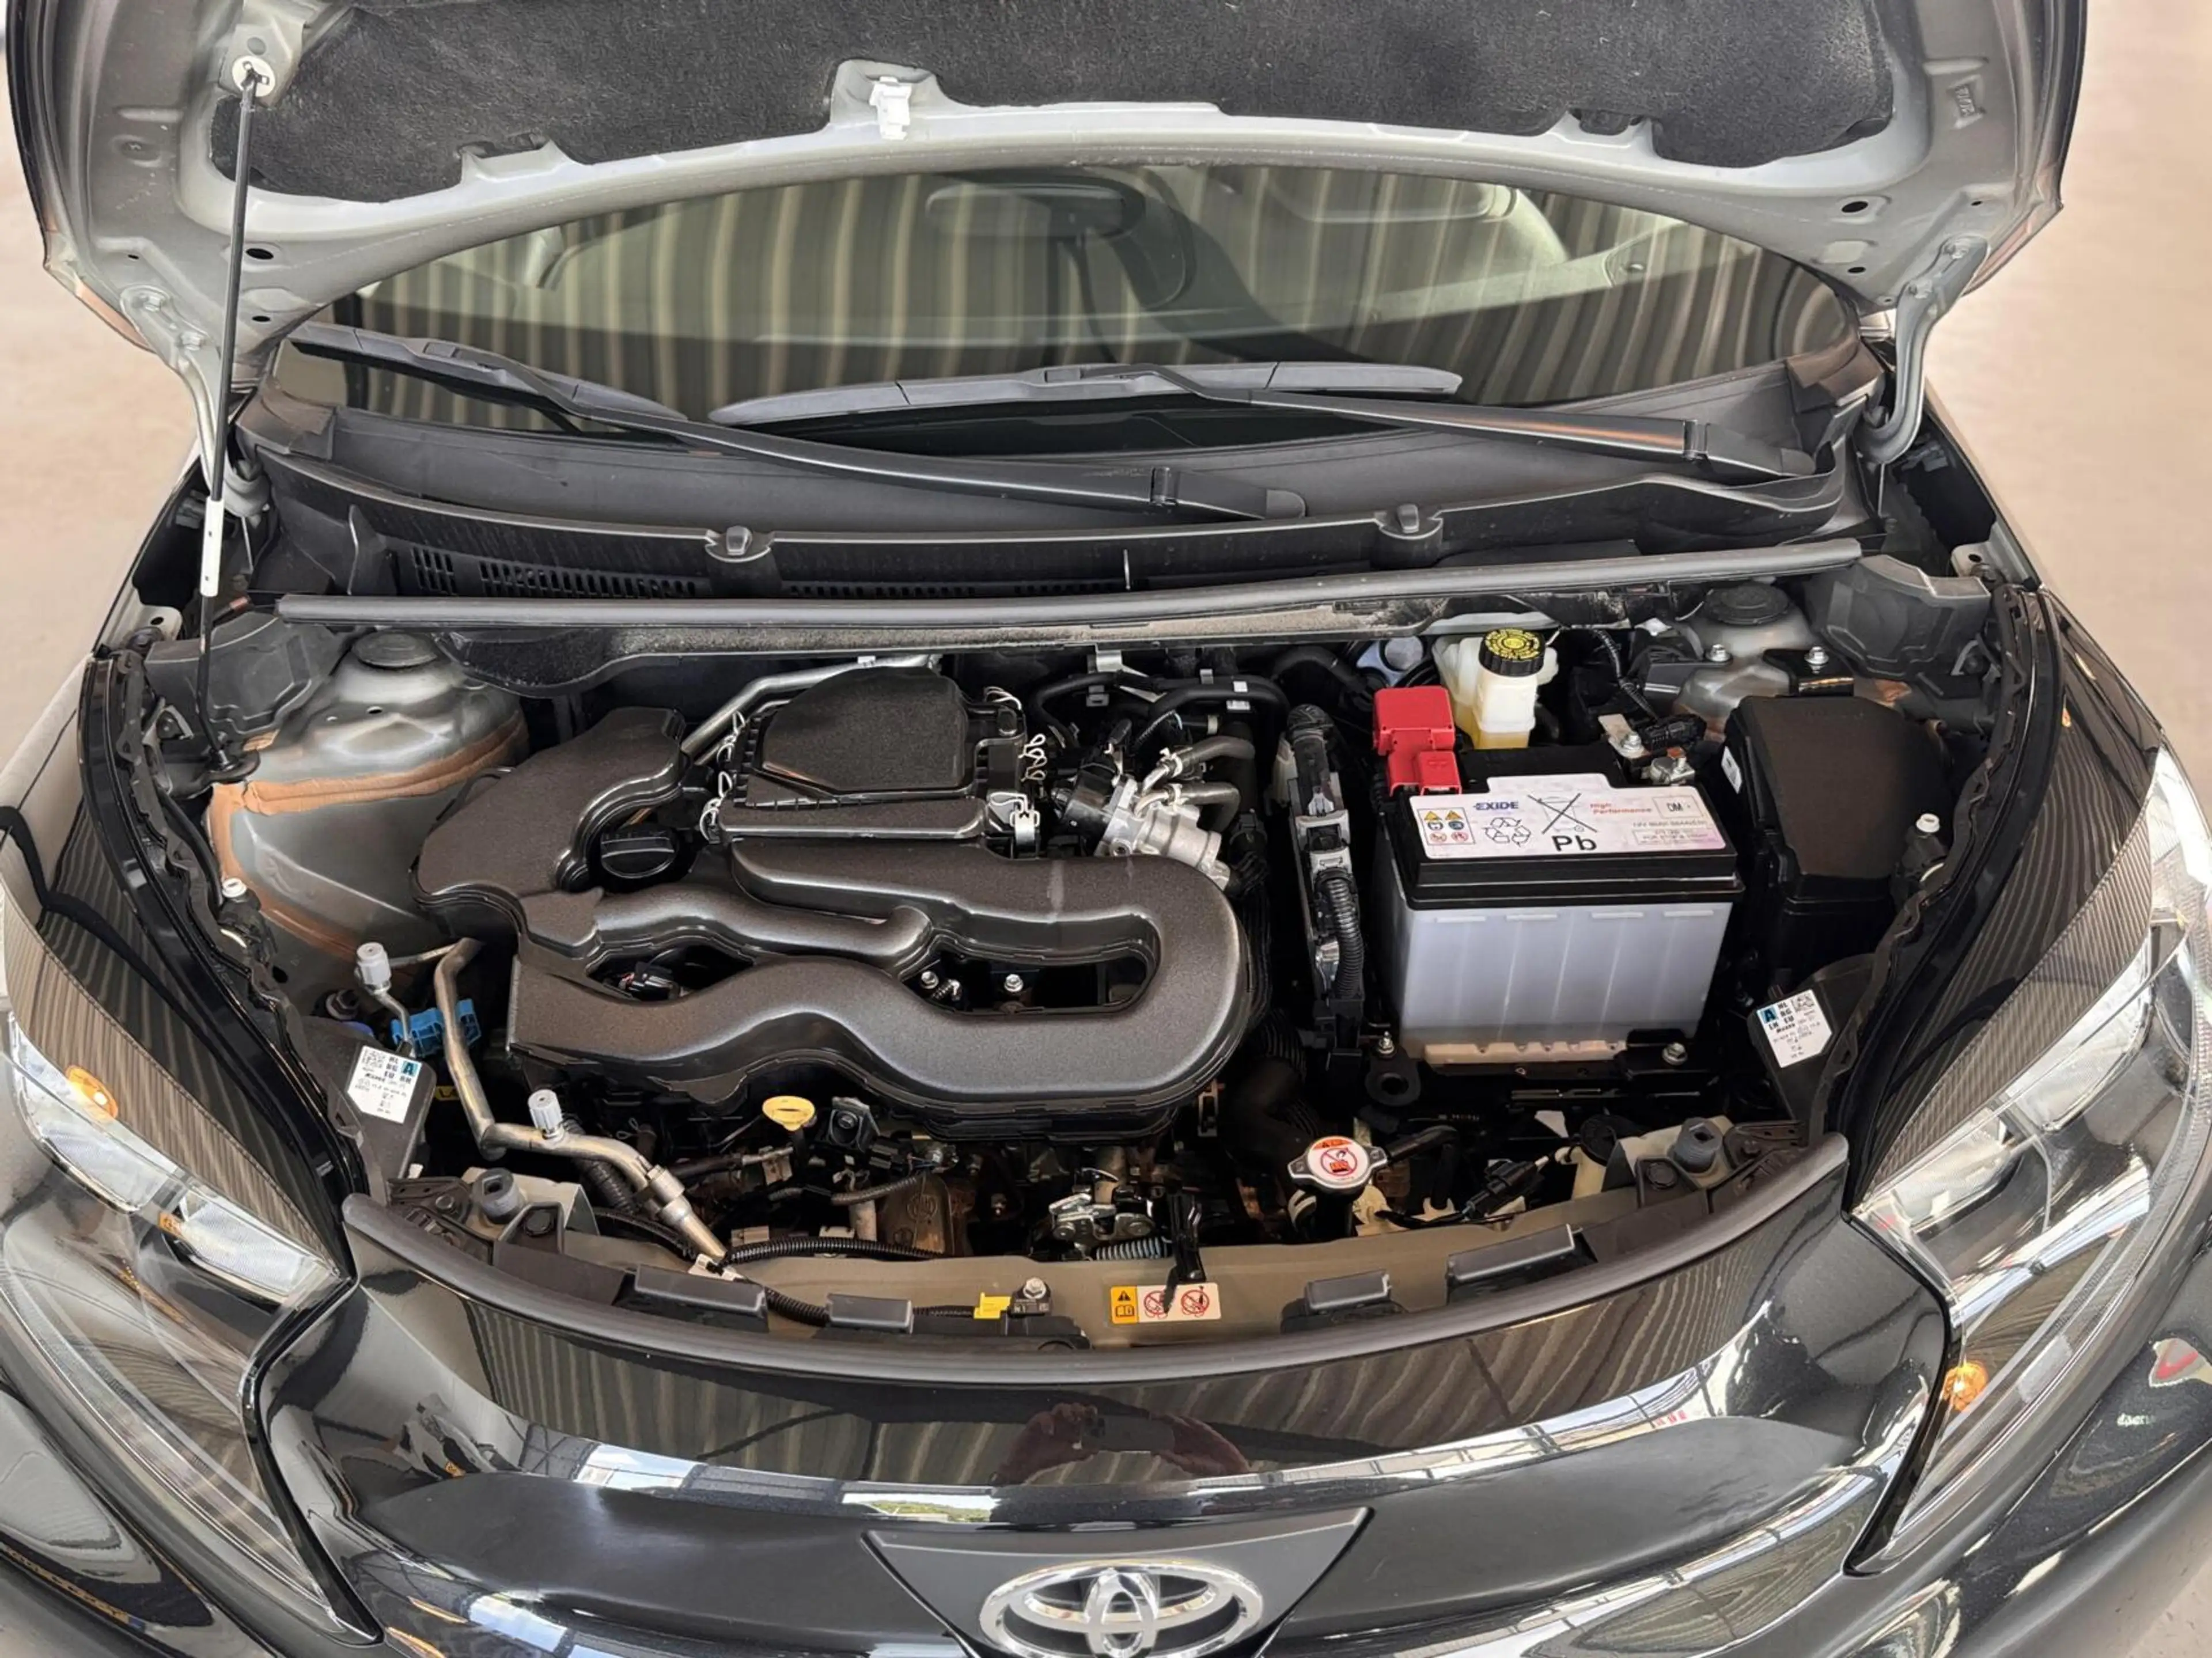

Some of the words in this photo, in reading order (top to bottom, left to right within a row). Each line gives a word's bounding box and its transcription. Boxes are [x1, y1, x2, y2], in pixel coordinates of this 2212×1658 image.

[1474, 801, 1518, 811] EXIDE
[1551, 834, 1597, 852] Pb
[1764, 1008, 1777, 1023] A
[404, 1062, 414, 1075] A
